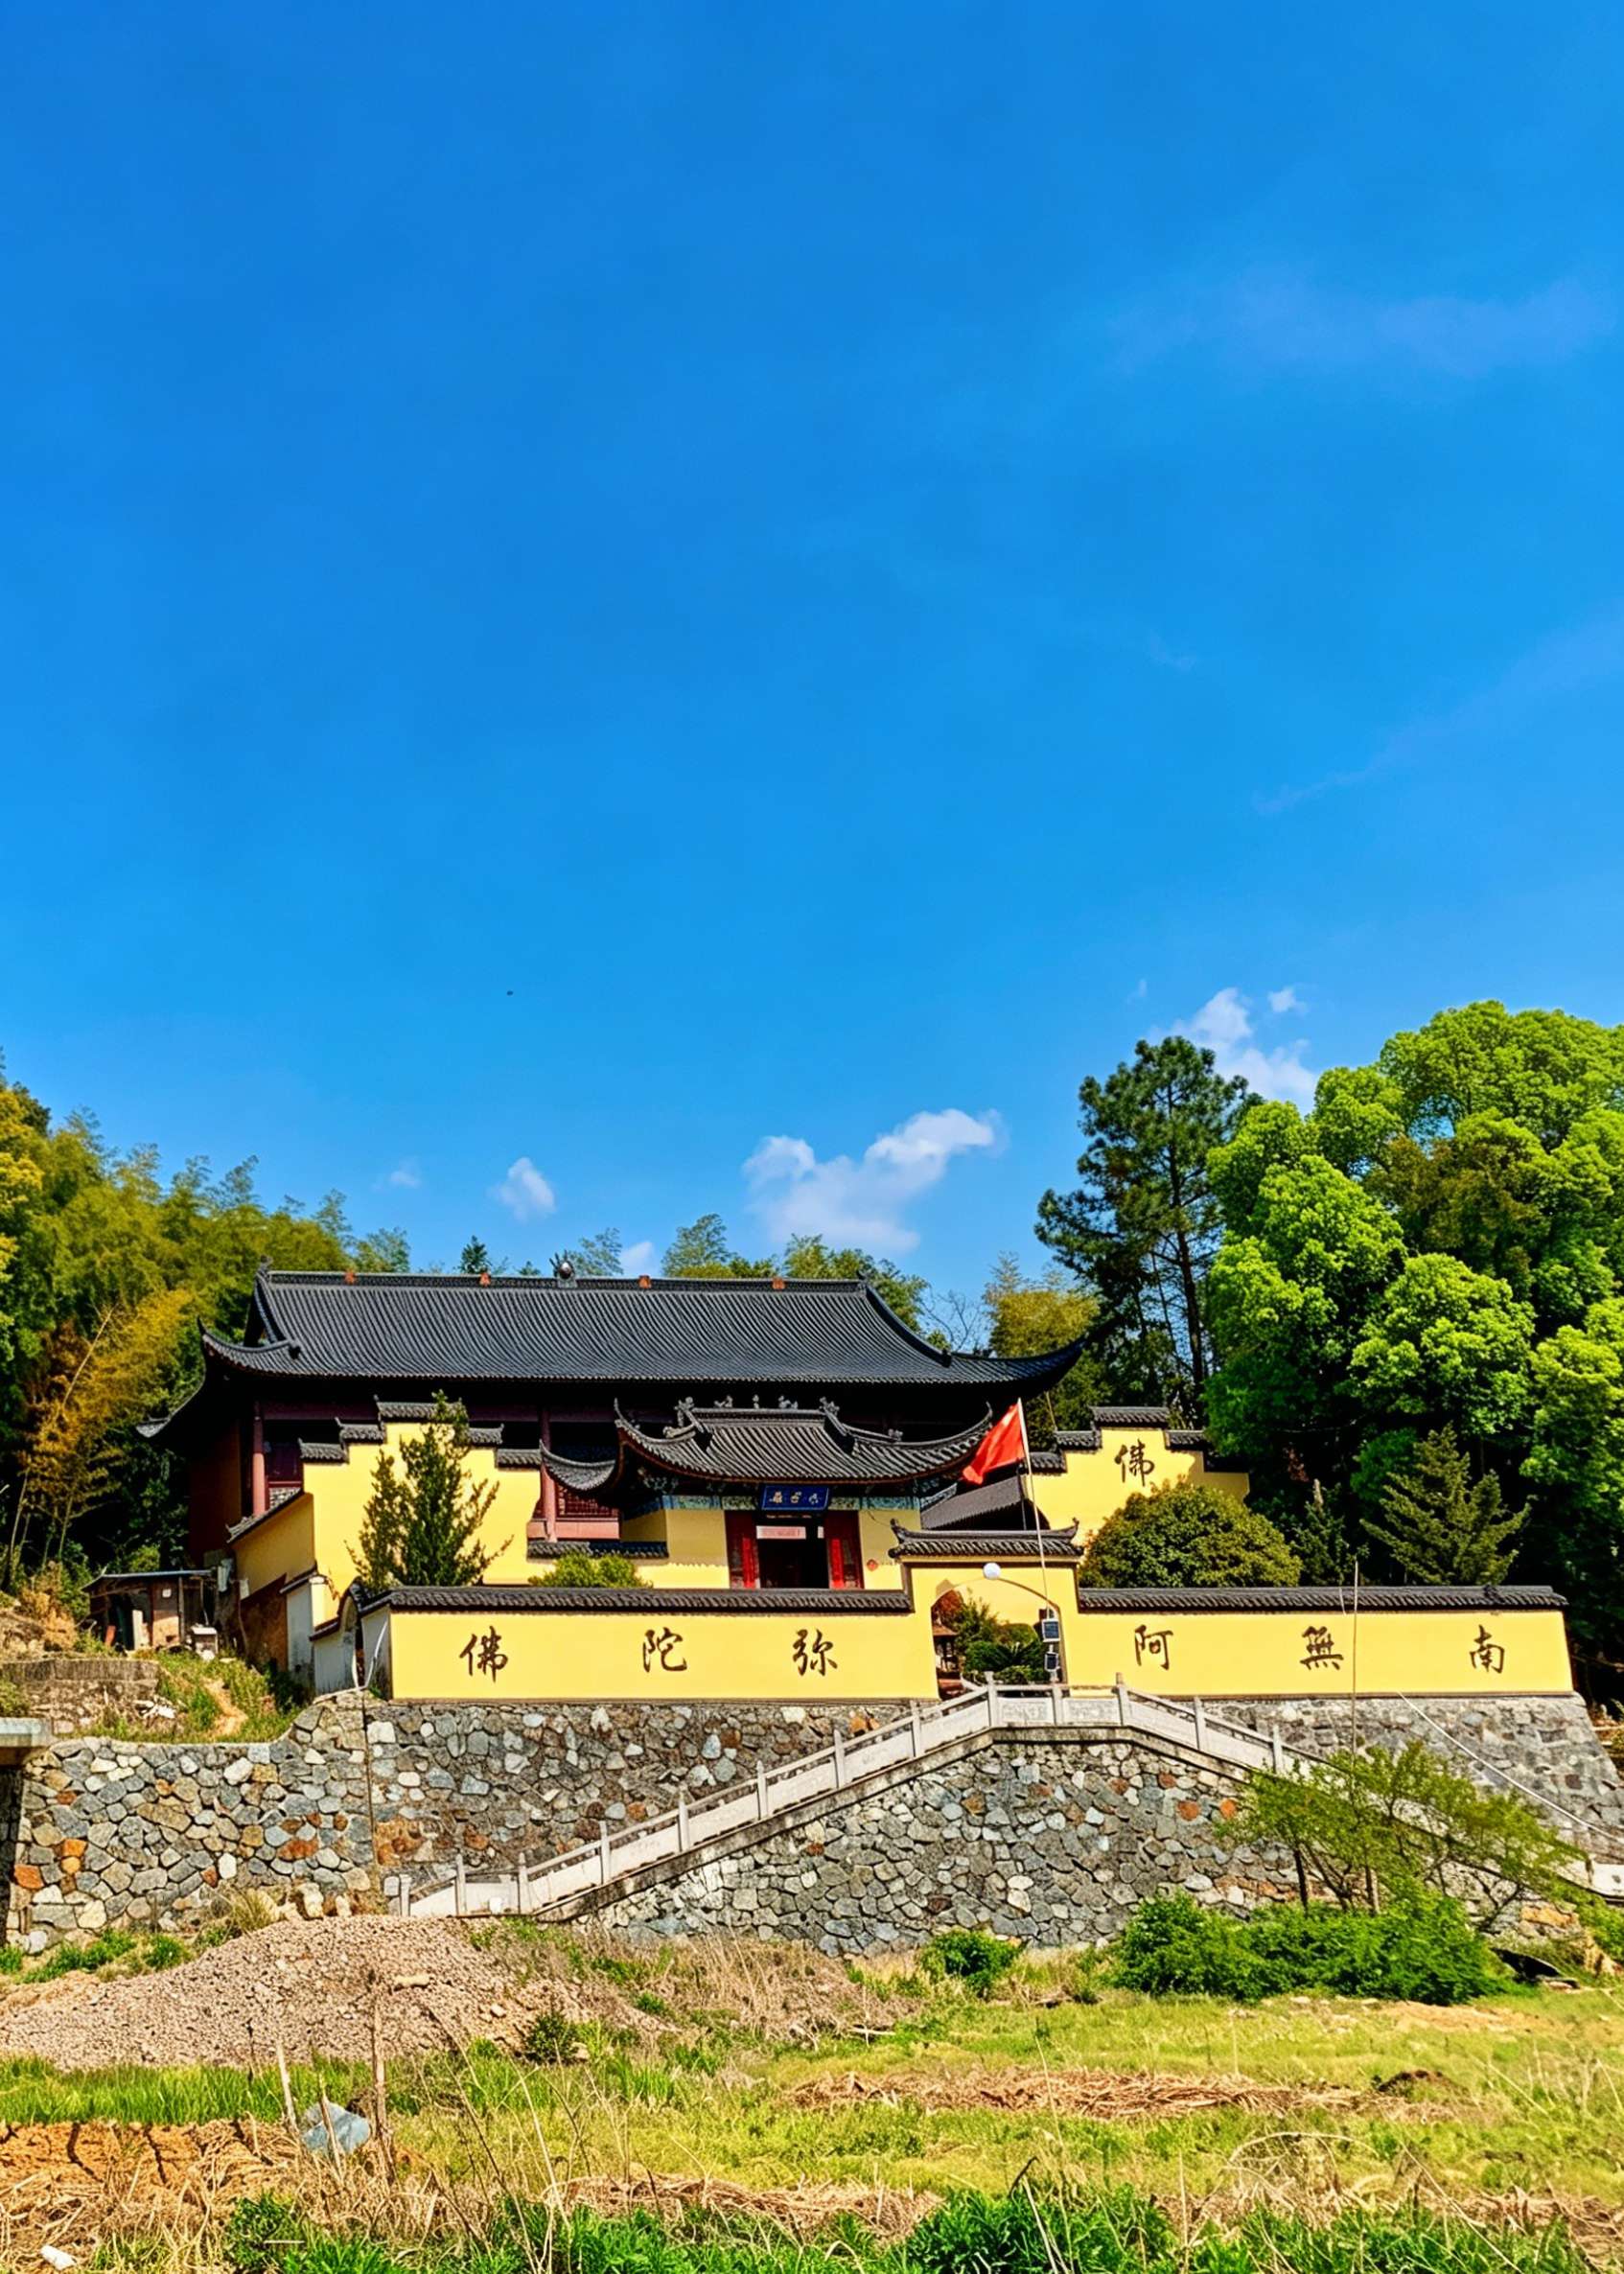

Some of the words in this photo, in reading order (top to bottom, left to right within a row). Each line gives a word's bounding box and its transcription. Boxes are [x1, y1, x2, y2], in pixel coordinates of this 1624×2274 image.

[642, 1626, 688, 1674] 陀
[1134, 1624, 1174, 1671] 阿
[1469, 1624, 1505, 1674] 南
